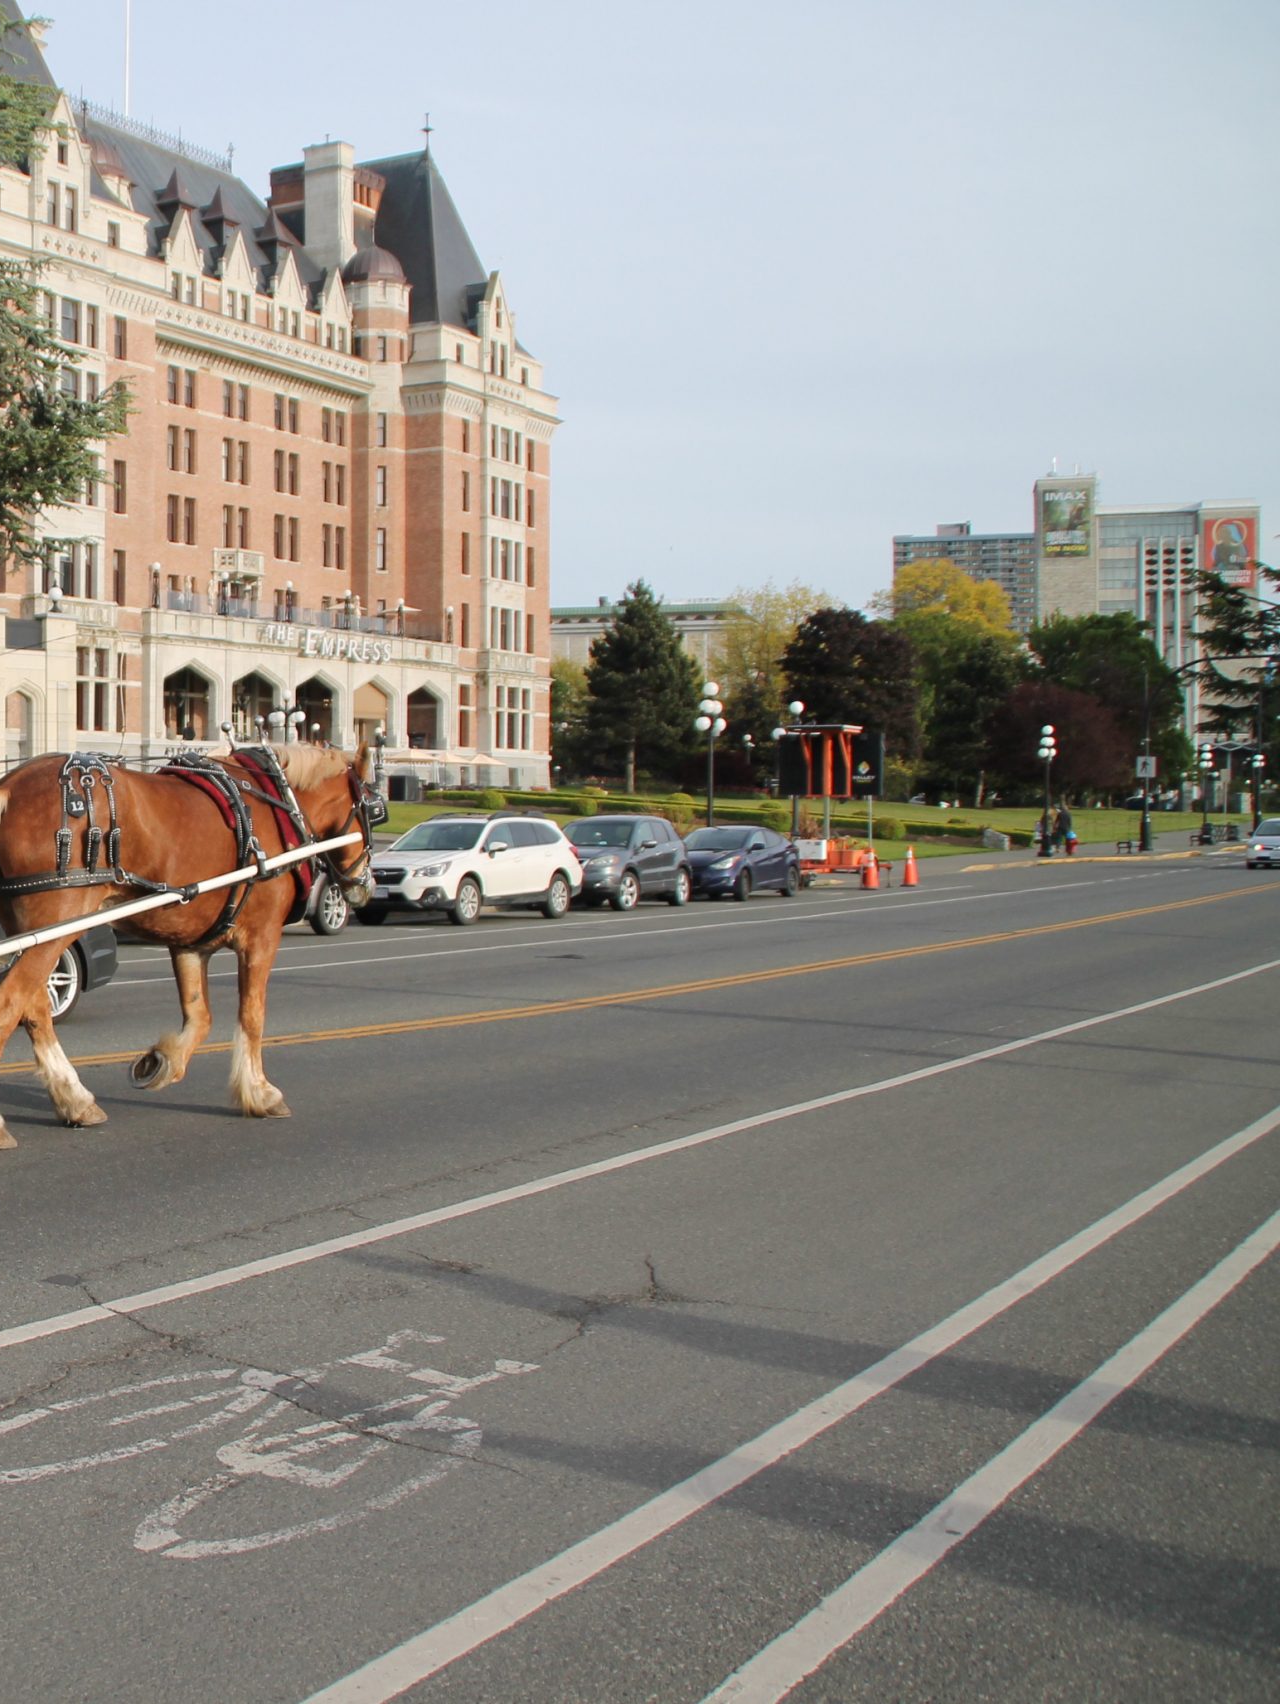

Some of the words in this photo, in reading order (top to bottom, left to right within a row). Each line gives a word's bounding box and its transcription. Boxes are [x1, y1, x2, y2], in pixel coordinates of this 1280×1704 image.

[1045, 491, 1086, 501] IMAX
[267, 624, 295, 641] THE
[304, 629, 392, 662] EMPRESS
[70, 800, 84, 811] 12
